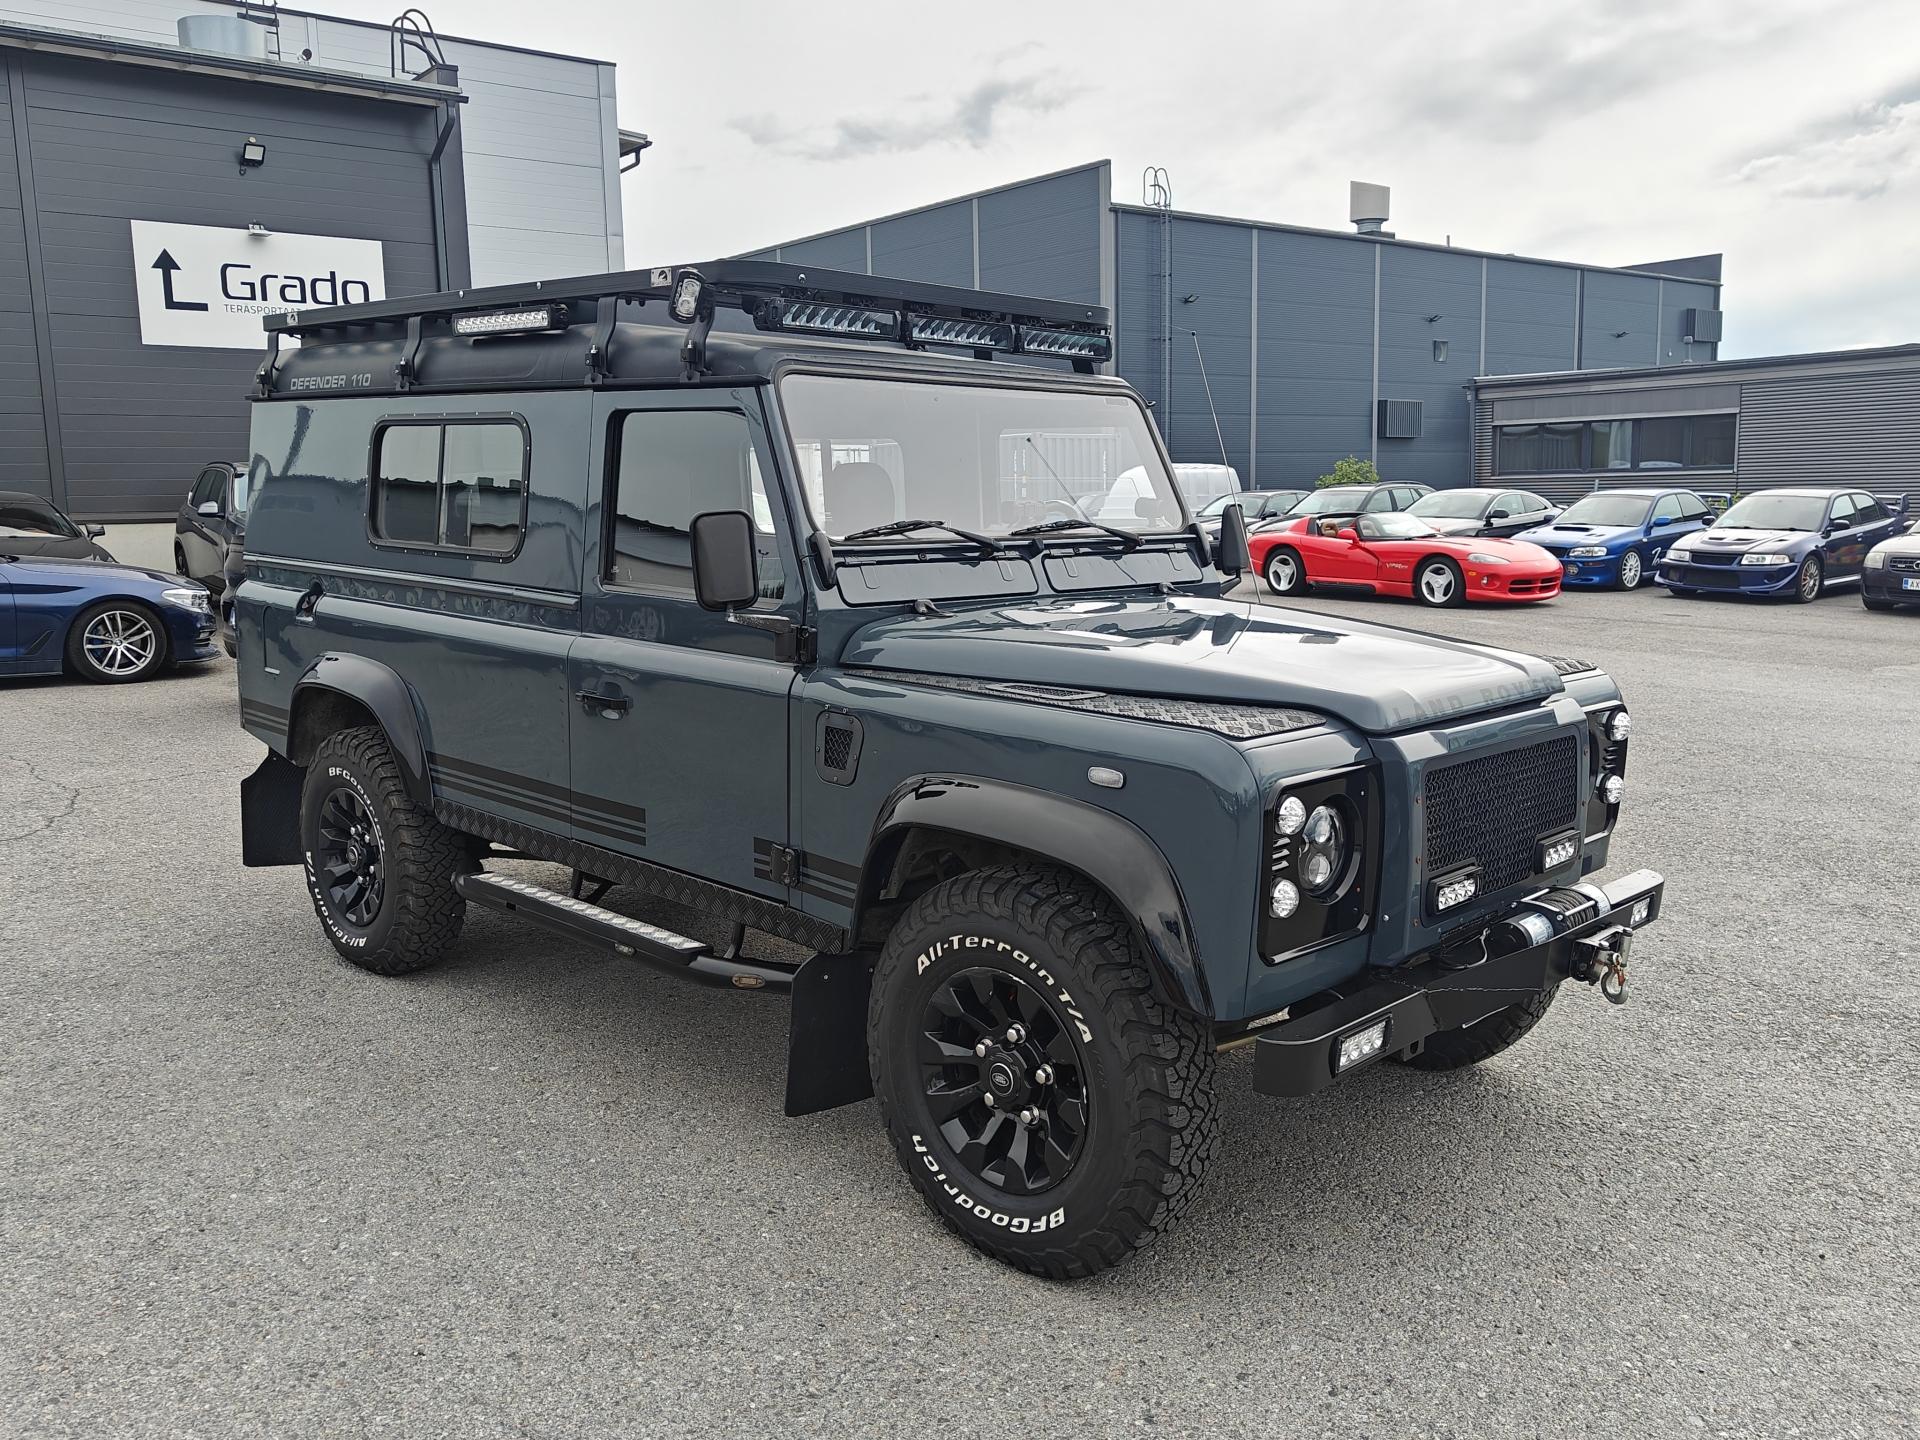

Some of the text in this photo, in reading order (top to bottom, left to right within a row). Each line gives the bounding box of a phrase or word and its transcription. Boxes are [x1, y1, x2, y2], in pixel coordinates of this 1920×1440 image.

[220, 262, 370, 306] Grado
[290, 373, 371, 390] DEFENDER 110
[914, 934, 1093, 1043] All-Terrain T/A
[912, 1135, 1066, 1233] BFGoodrich
